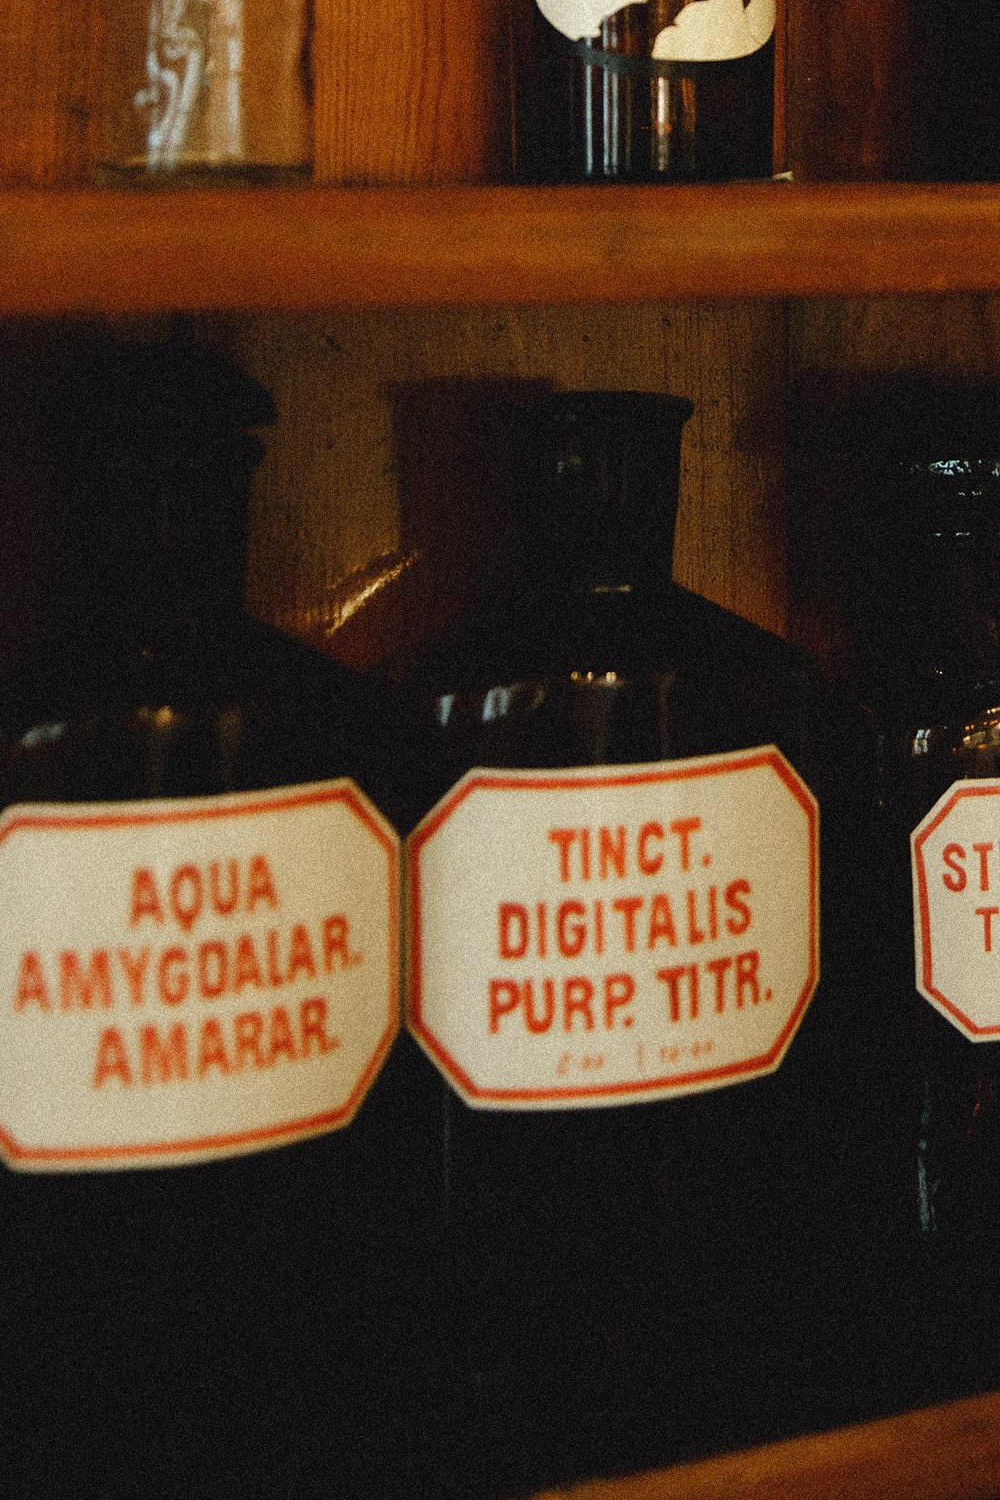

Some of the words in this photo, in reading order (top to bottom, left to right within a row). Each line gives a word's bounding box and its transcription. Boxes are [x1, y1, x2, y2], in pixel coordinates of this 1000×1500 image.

[548, 816, 713, 884] TINCT.
[130, 854, 280, 932] AQUA
[498, 878, 754, 962] DIGITALIS
[13, 914, 365, 1016] AMYGDALAR.
[487, 977, 634, 1036] PURP.
[657, 950, 775, 1025] TITR.
[92, 996, 343, 1090] AMARAR.
